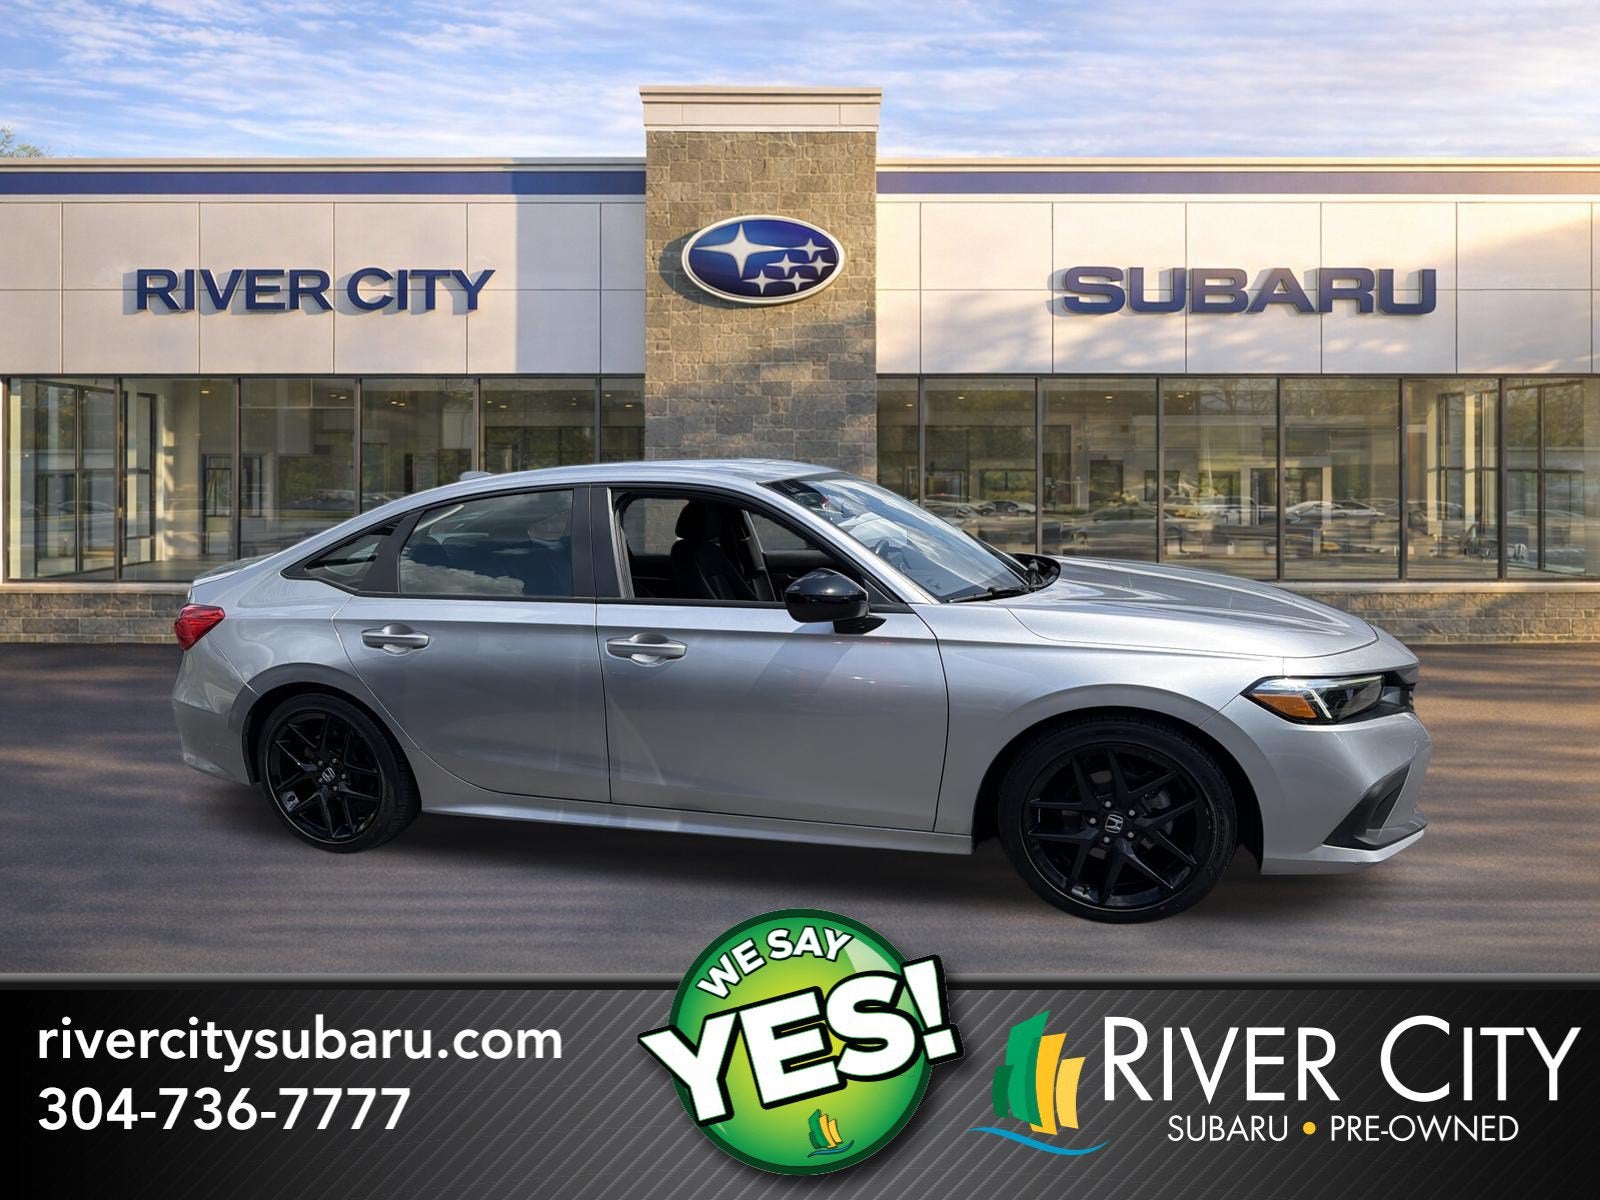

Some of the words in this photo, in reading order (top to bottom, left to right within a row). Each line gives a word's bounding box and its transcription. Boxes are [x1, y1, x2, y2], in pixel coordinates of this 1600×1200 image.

[137, 269, 333, 310] RIVER
[346, 267, 496, 311] CITY
[1063, 266, 1437, 314] SUBARU
